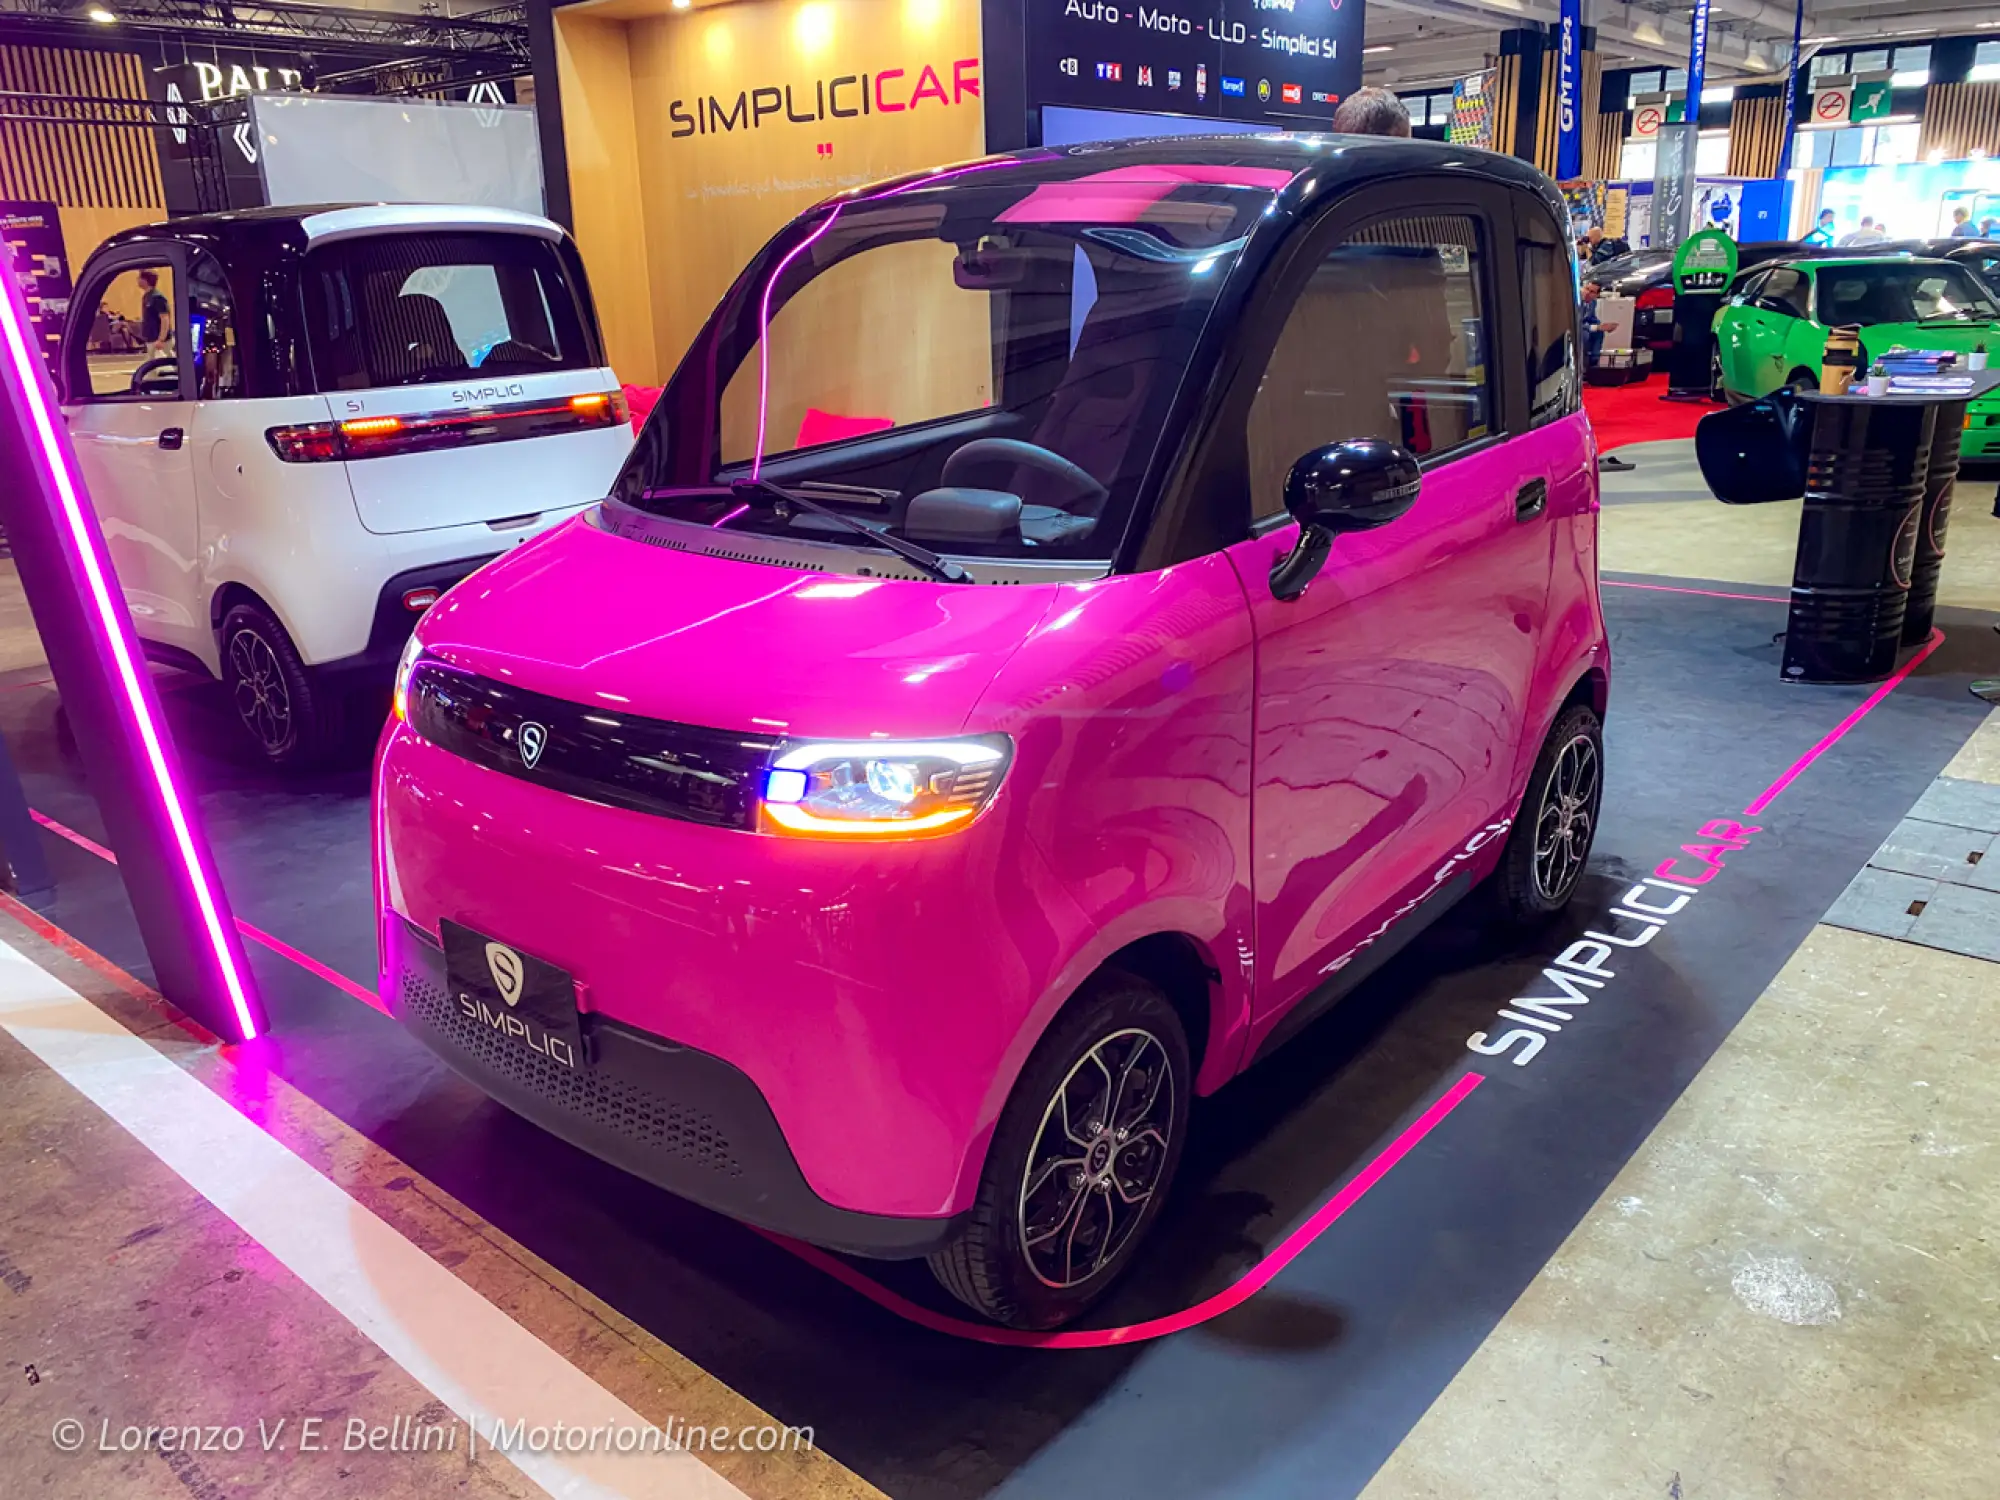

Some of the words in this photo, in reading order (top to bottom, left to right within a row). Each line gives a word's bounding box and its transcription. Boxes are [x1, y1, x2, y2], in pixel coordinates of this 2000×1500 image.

[1065, 0, 1118, 23] Auto
[1139, 5, 1191, 35] Moto
[1208, 18, 1246, 44] LLD
[1261, 27, 1320, 57] Simplici
[670, 57, 980, 139] SIMPLICICAR
[1560, 15, 1574, 132] GMT94
[452, 384, 525, 402] SIMPLICI
[1466, 818, 1764, 1067] SIMPLICICAR
[459, 993, 575, 1068] SIMPLICI
